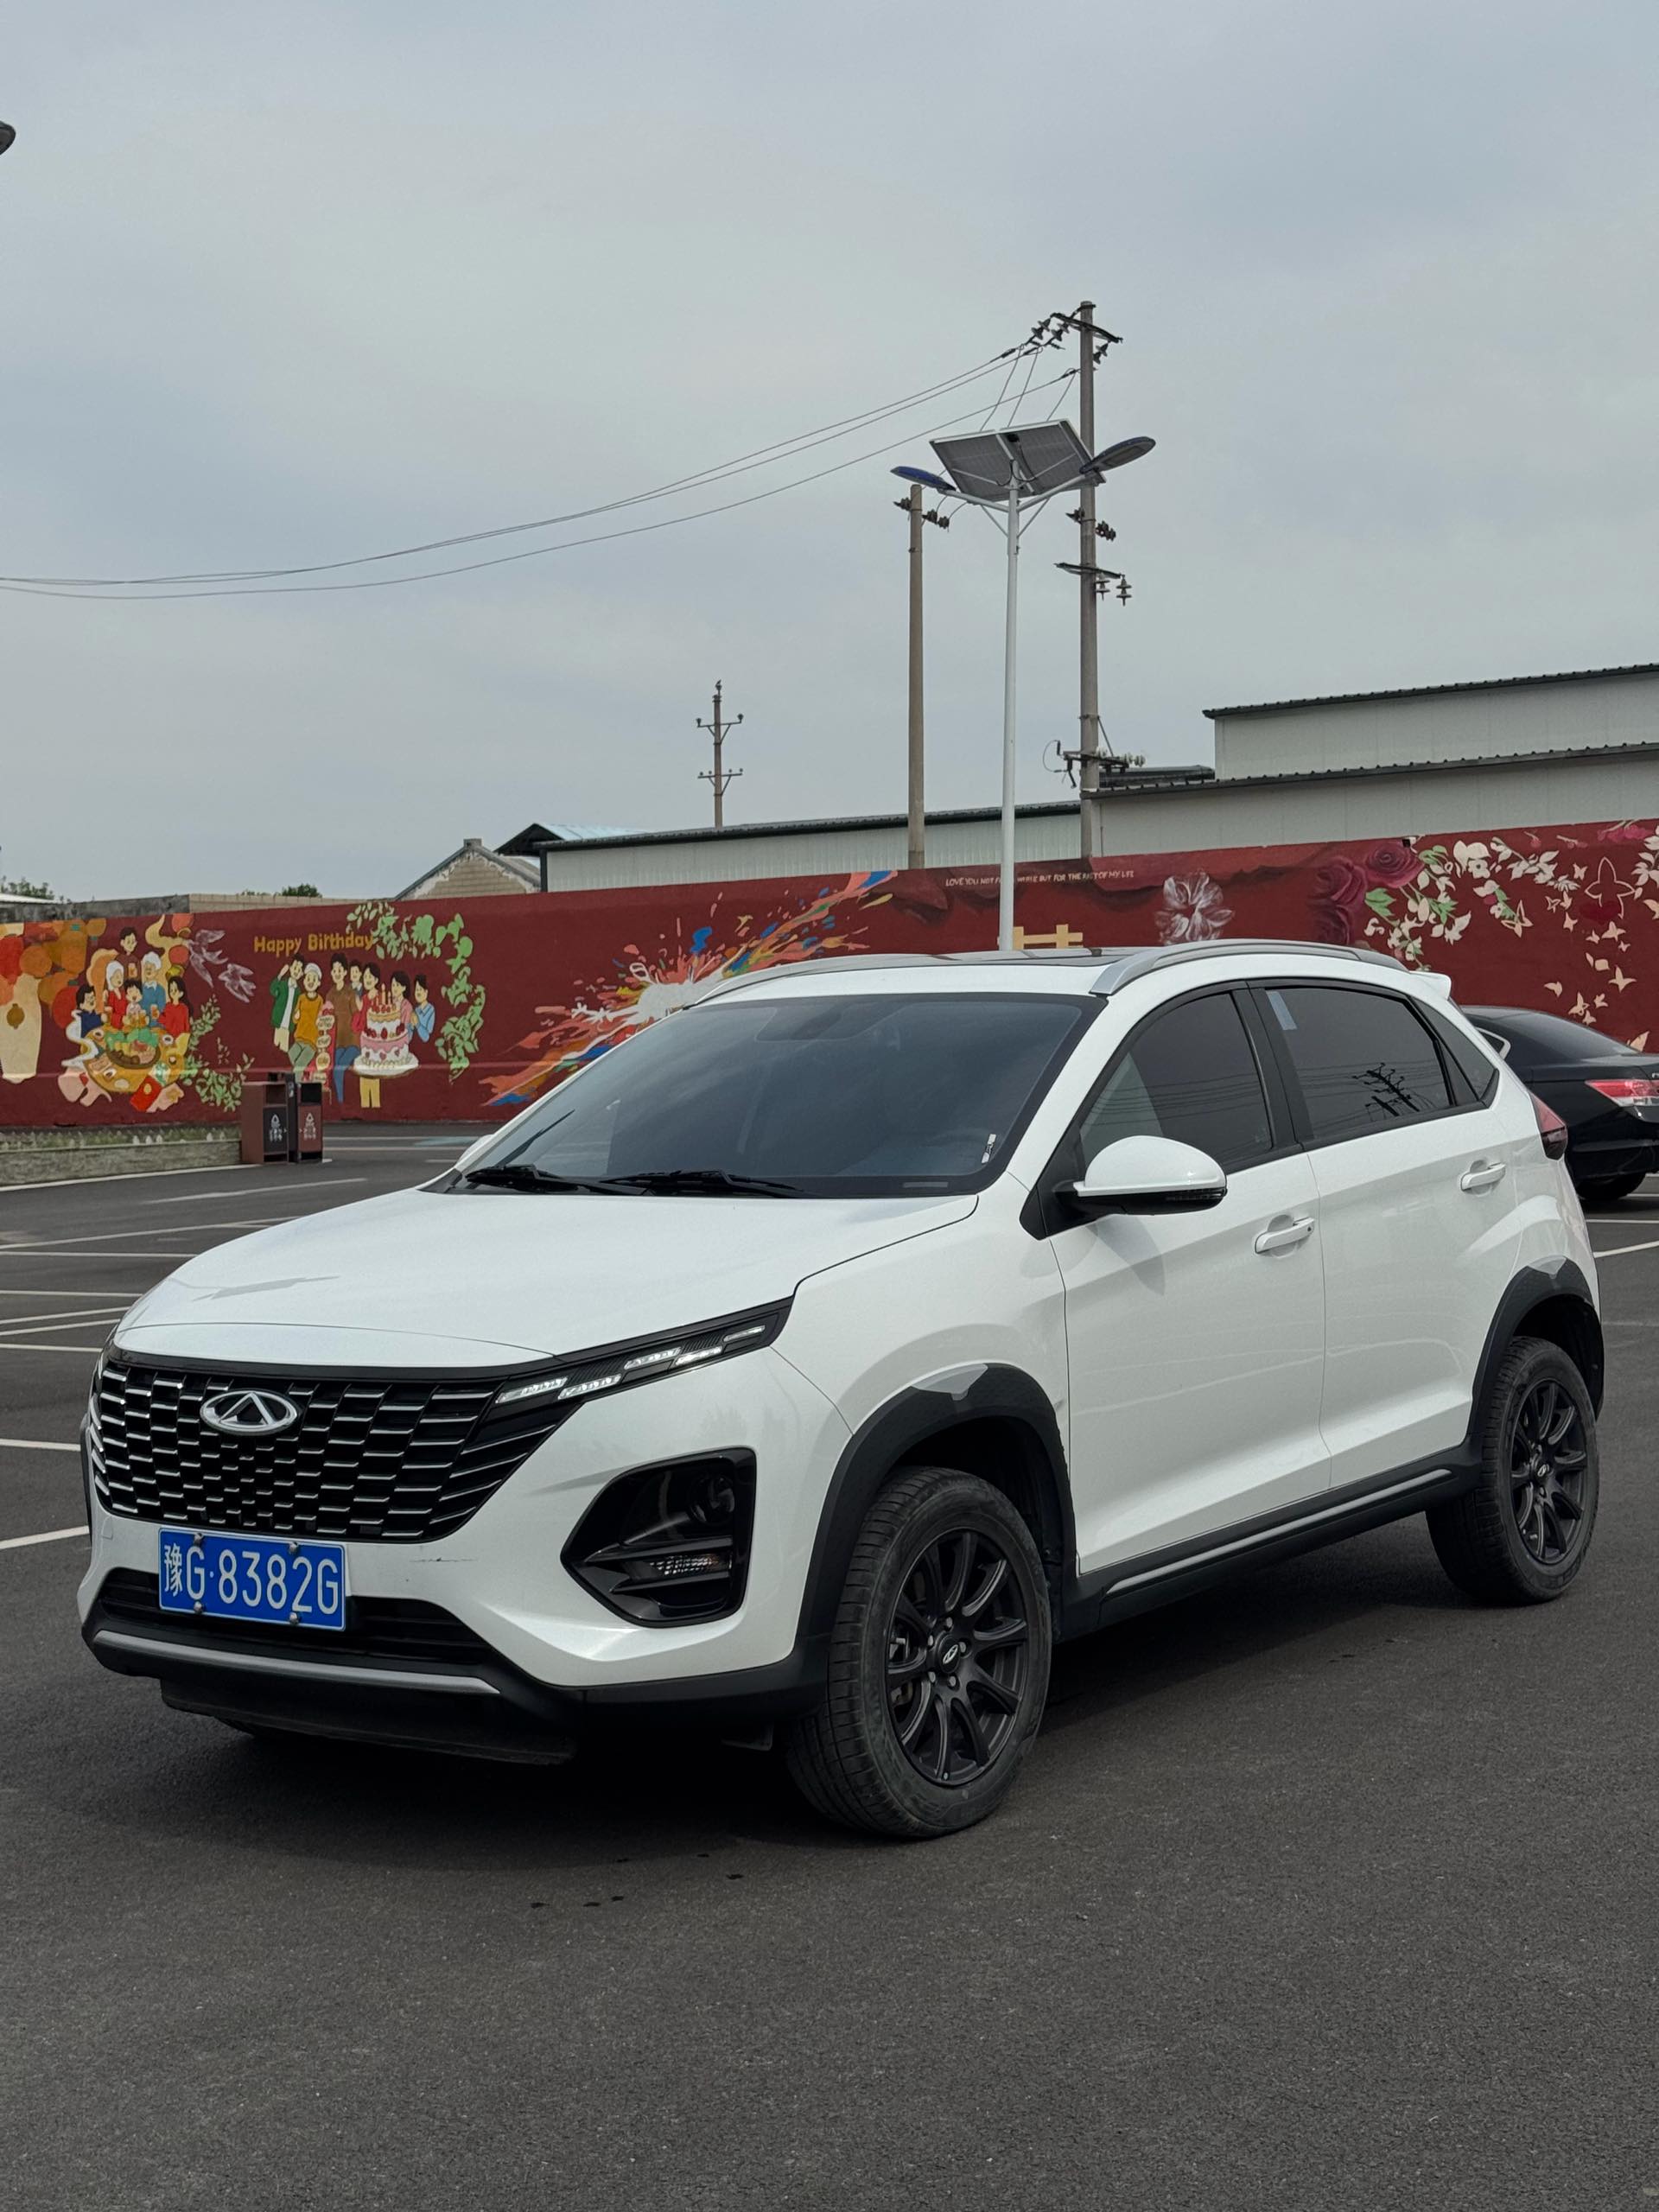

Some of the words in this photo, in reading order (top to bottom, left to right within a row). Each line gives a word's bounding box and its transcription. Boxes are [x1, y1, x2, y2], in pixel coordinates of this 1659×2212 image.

[945, 877, 964, 887] LOVE
[965, 877, 979, 886] YOU
[1053, 874, 1066, 882] FOR
[1098, 871, 1109, 880] OF
[1109, 870, 1121, 879] MY
[254, 936, 302, 957] Happy
[308, 931, 374, 951] Birthday
[164, 1542, 339, 1615] 豫G·8382G
